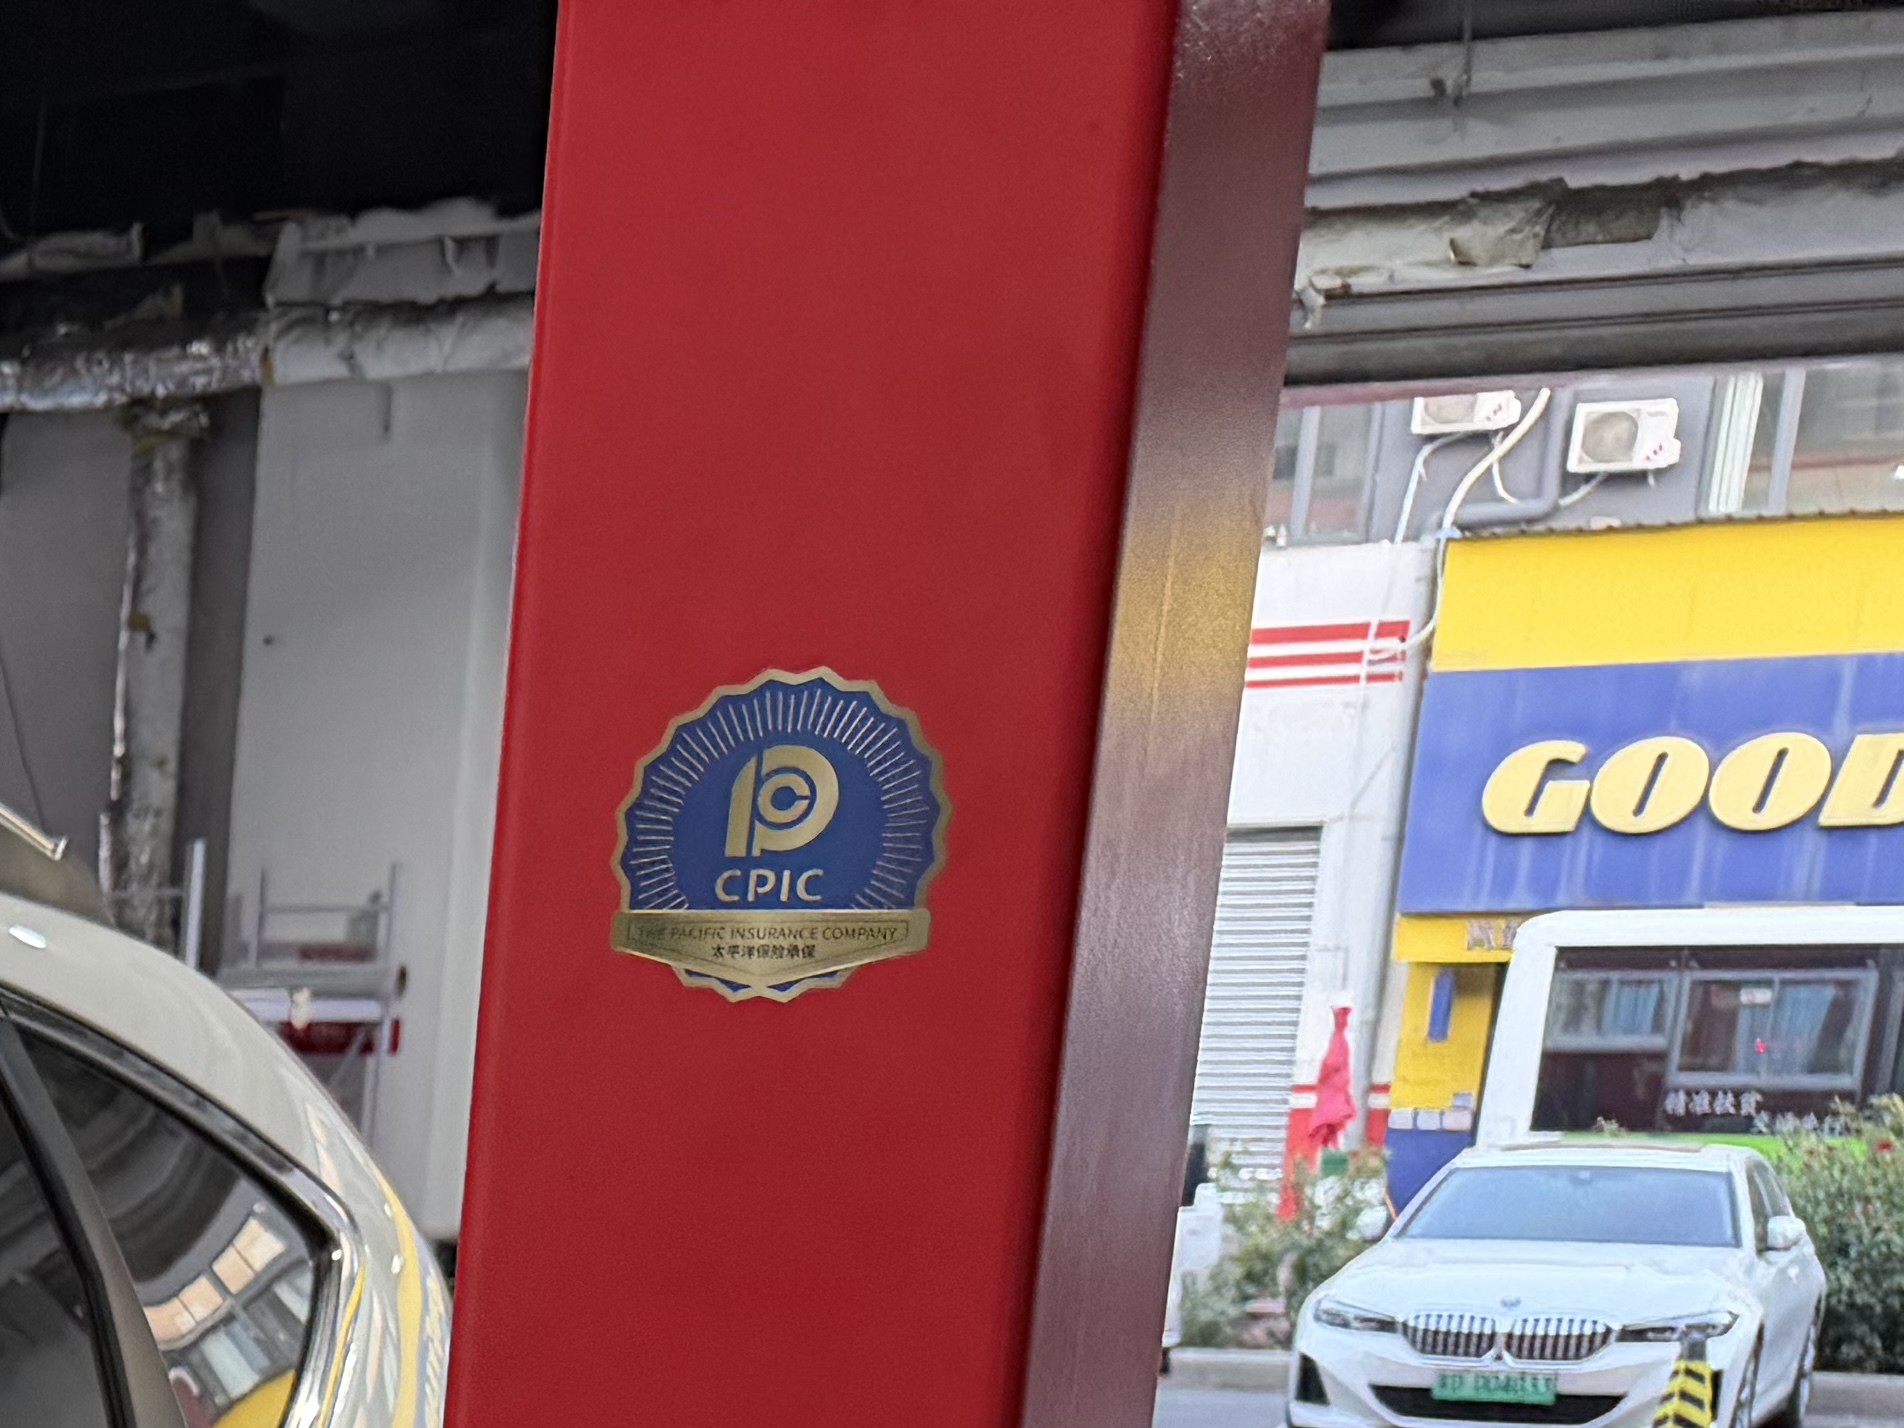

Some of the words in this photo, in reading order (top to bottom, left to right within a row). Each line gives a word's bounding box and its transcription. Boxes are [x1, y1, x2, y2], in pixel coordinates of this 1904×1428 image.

[714, 868, 824, 902] CPIC
[669, 926, 726, 941] PACIFIC
[730, 926, 819, 941] INSURANCE
[822, 926, 897, 941] COMPANY
